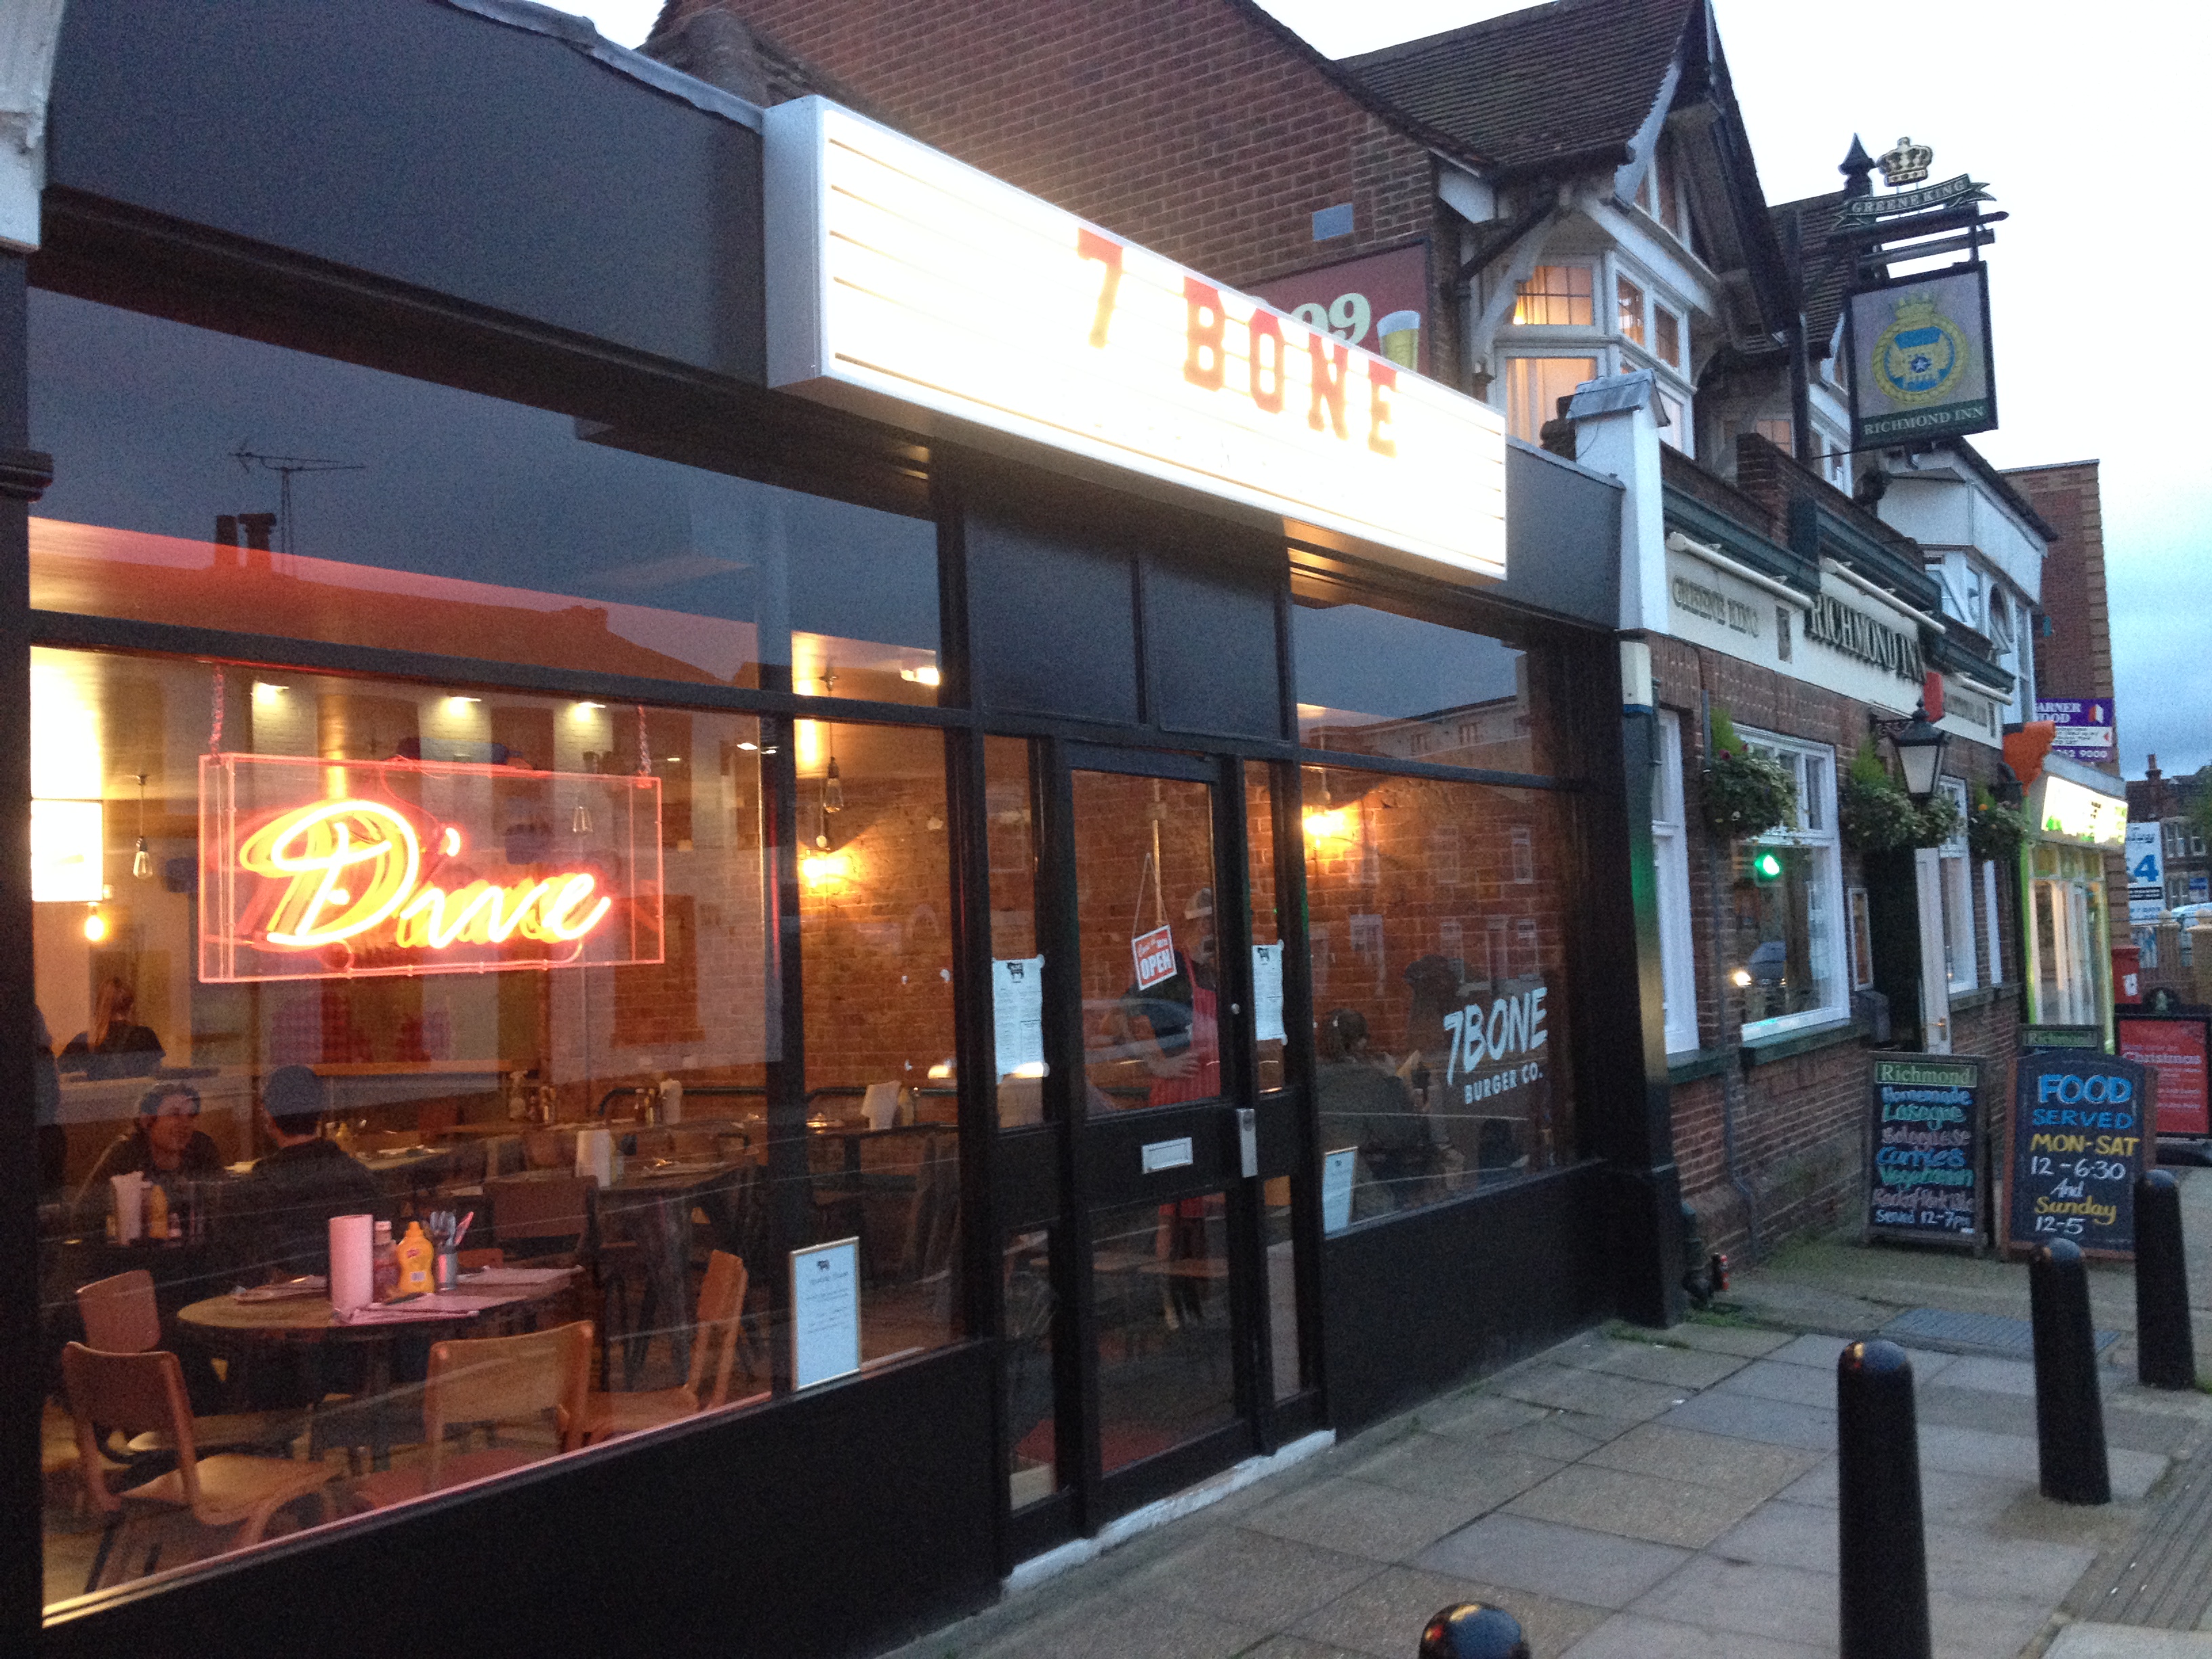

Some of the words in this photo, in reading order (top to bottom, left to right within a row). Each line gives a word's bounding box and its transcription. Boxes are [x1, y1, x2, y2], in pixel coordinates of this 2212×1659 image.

[1851, 194, 1920, 213] GREENE
[1923, 180, 1965, 202] KING
[1078, 227, 1124, 350] 7
[1183, 275, 1398, 459] BONE
[1864, 411, 1950, 435] RICHMOND
[1954, 406, 1985, 421] INN
[1809, 593, 1898, 670] RICHMOND
[2034, 702, 2081, 713] ARNER
[1141, 948, 1173, 980] OPEN
[1464, 1069, 1517, 1105] BURGER
[1521, 1061, 1544, 1084] CO.
[1881, 1063, 1971, 1084] Richmond
[2037, 1073, 2133, 1105] FOOD
[2032, 1107, 2134, 1130] SERVED
[2030, 1132, 2141, 1157] MON-SAT
[2049, 1177, 2085, 1199] And
[2034, 1194, 2117, 1226] Sunday
[2034, 1215, 2086, 1235] 12-5
